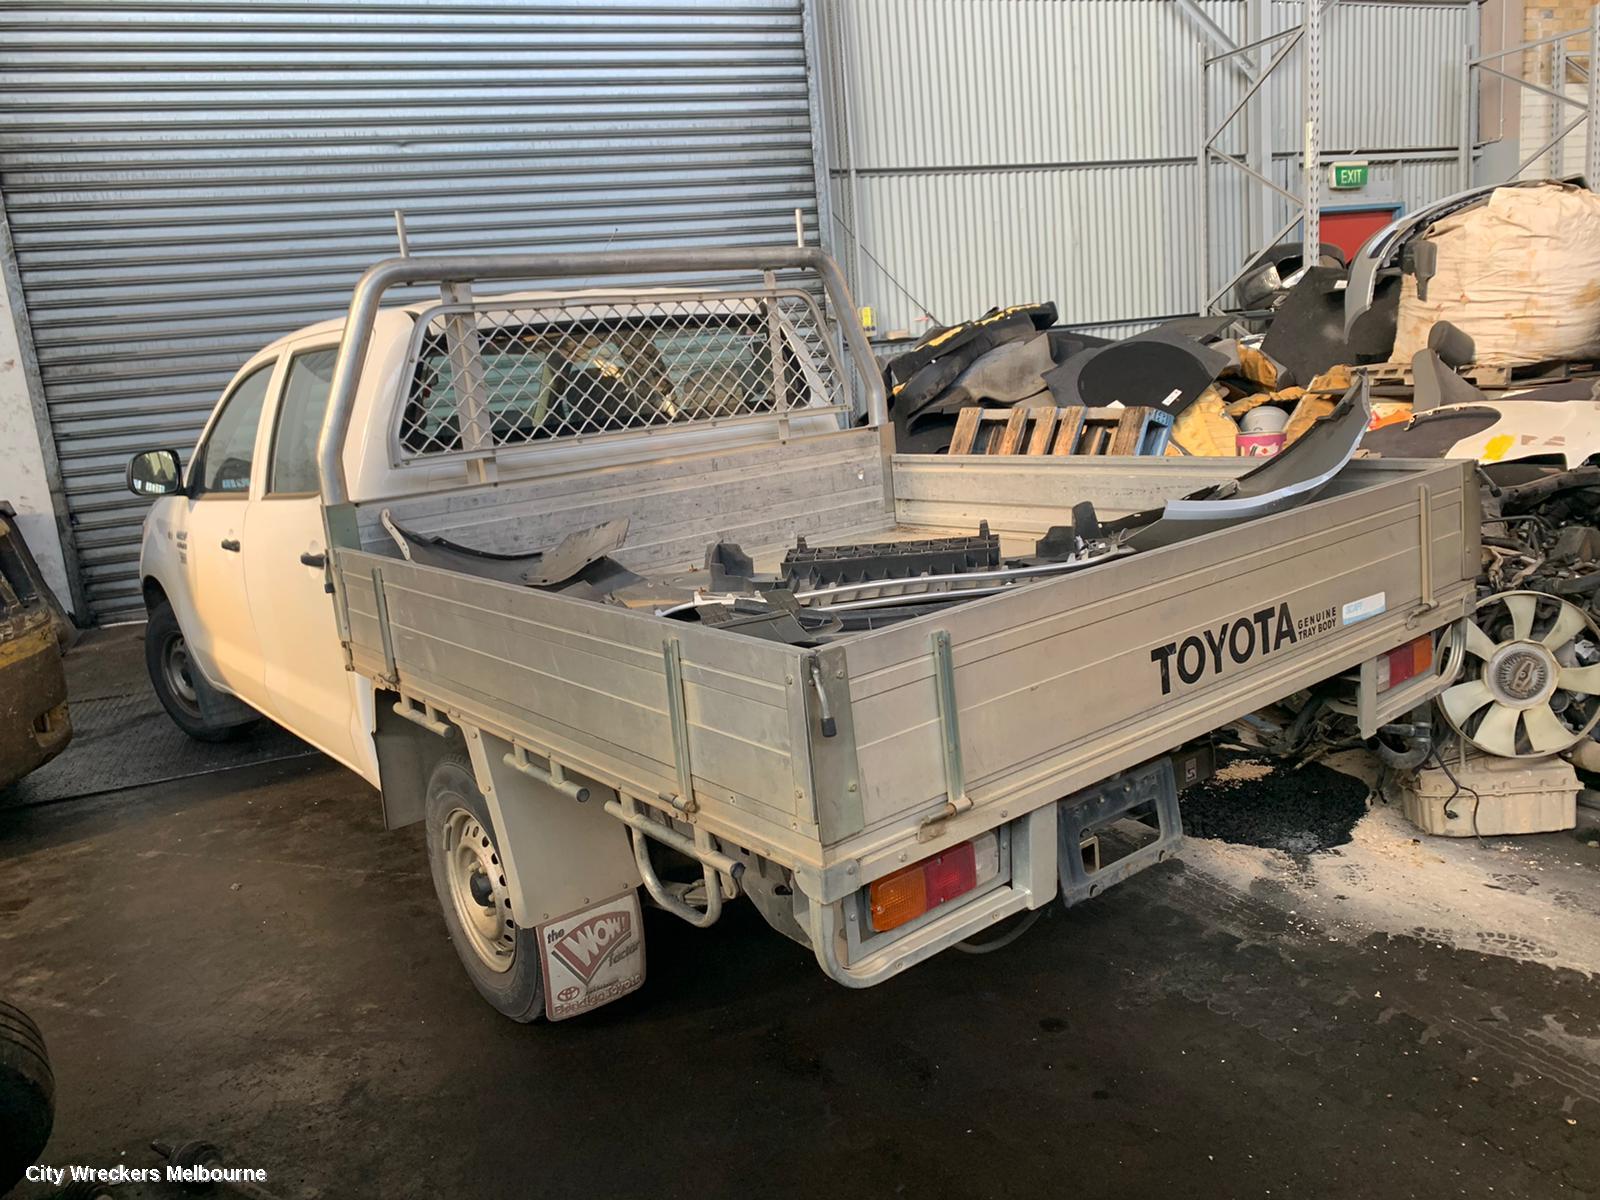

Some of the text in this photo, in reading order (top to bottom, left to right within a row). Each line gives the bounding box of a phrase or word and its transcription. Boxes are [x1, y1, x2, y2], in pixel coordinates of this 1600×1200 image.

[1341, 169, 1362, 184] EXIT
[1297, 606, 1337, 630] GENUINE
[1298, 617, 1337, 640] TRAY BODY
[1151, 602, 1298, 695] TOYOTA
[547, 928, 565, 944] the
[561, 915, 626, 968] WOW!
